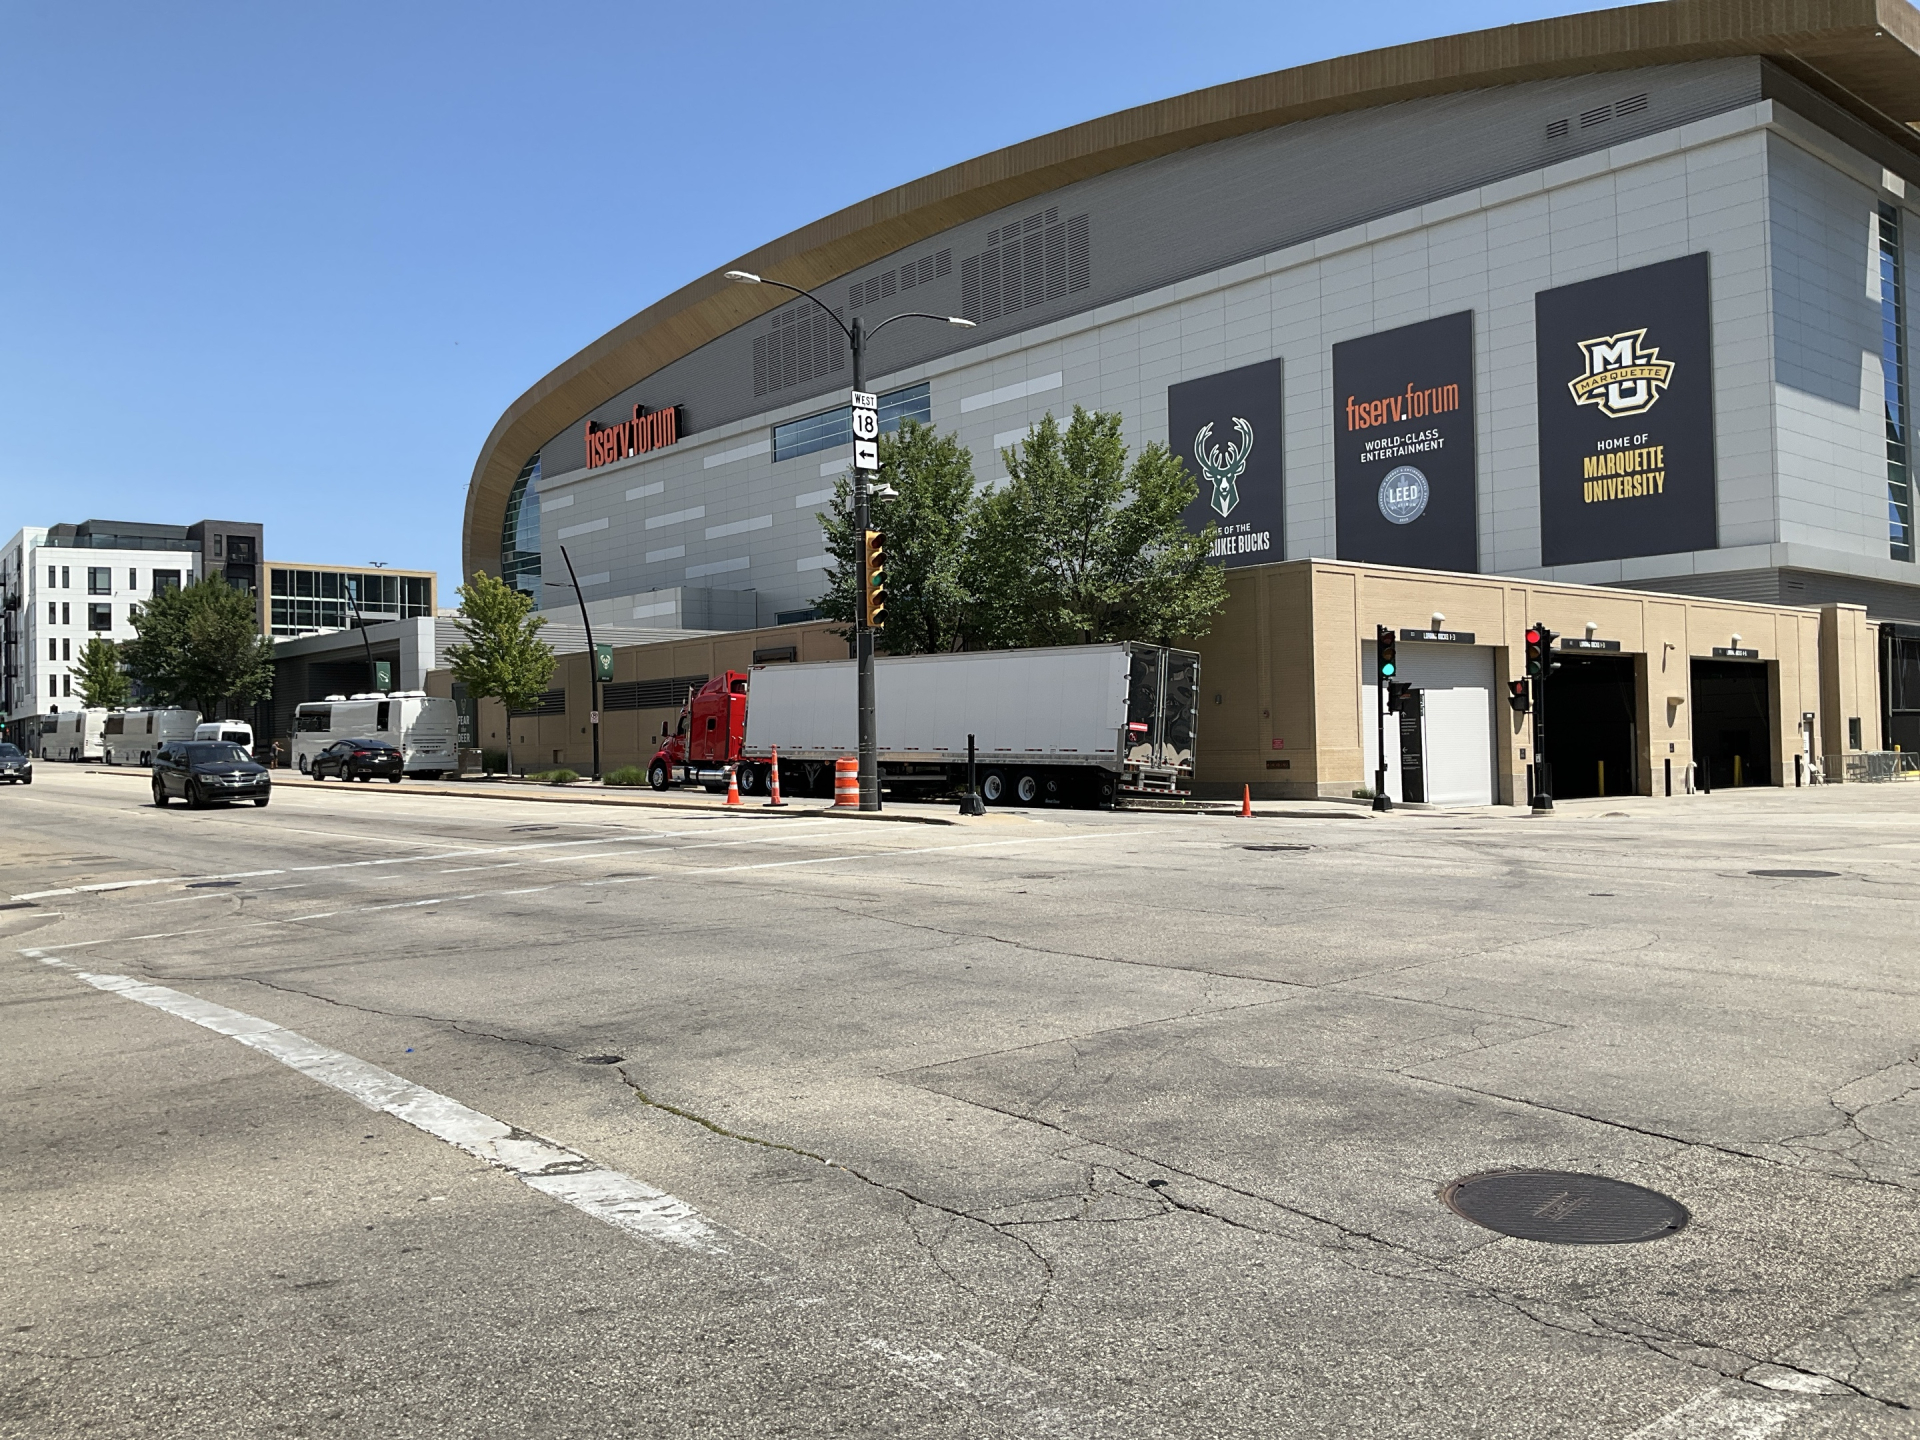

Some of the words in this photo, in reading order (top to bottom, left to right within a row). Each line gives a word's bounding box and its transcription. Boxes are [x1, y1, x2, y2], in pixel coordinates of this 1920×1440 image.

[1580, 368, 1662, 391] MARQUETTE
[854, 393, 874, 407] WEST
[857, 414, 874, 433] 18
[1360, 438, 1445, 463] ENTERTAINMENT
[1365, 428, 1439, 451] WORLD-CLASS
[1597, 436, 1630, 451] HOME
[1633, 433, 1649, 445] OF
[1583, 445, 1664, 479] MARQUETTE
[1389, 485, 1418, 503] LEED
[1583, 470, 1665, 503] UNIVERSITY
[1224, 525, 1234, 535] OF
[1235, 522, 1251, 533] THE
[1238, 531, 1270, 554] BUCKS
